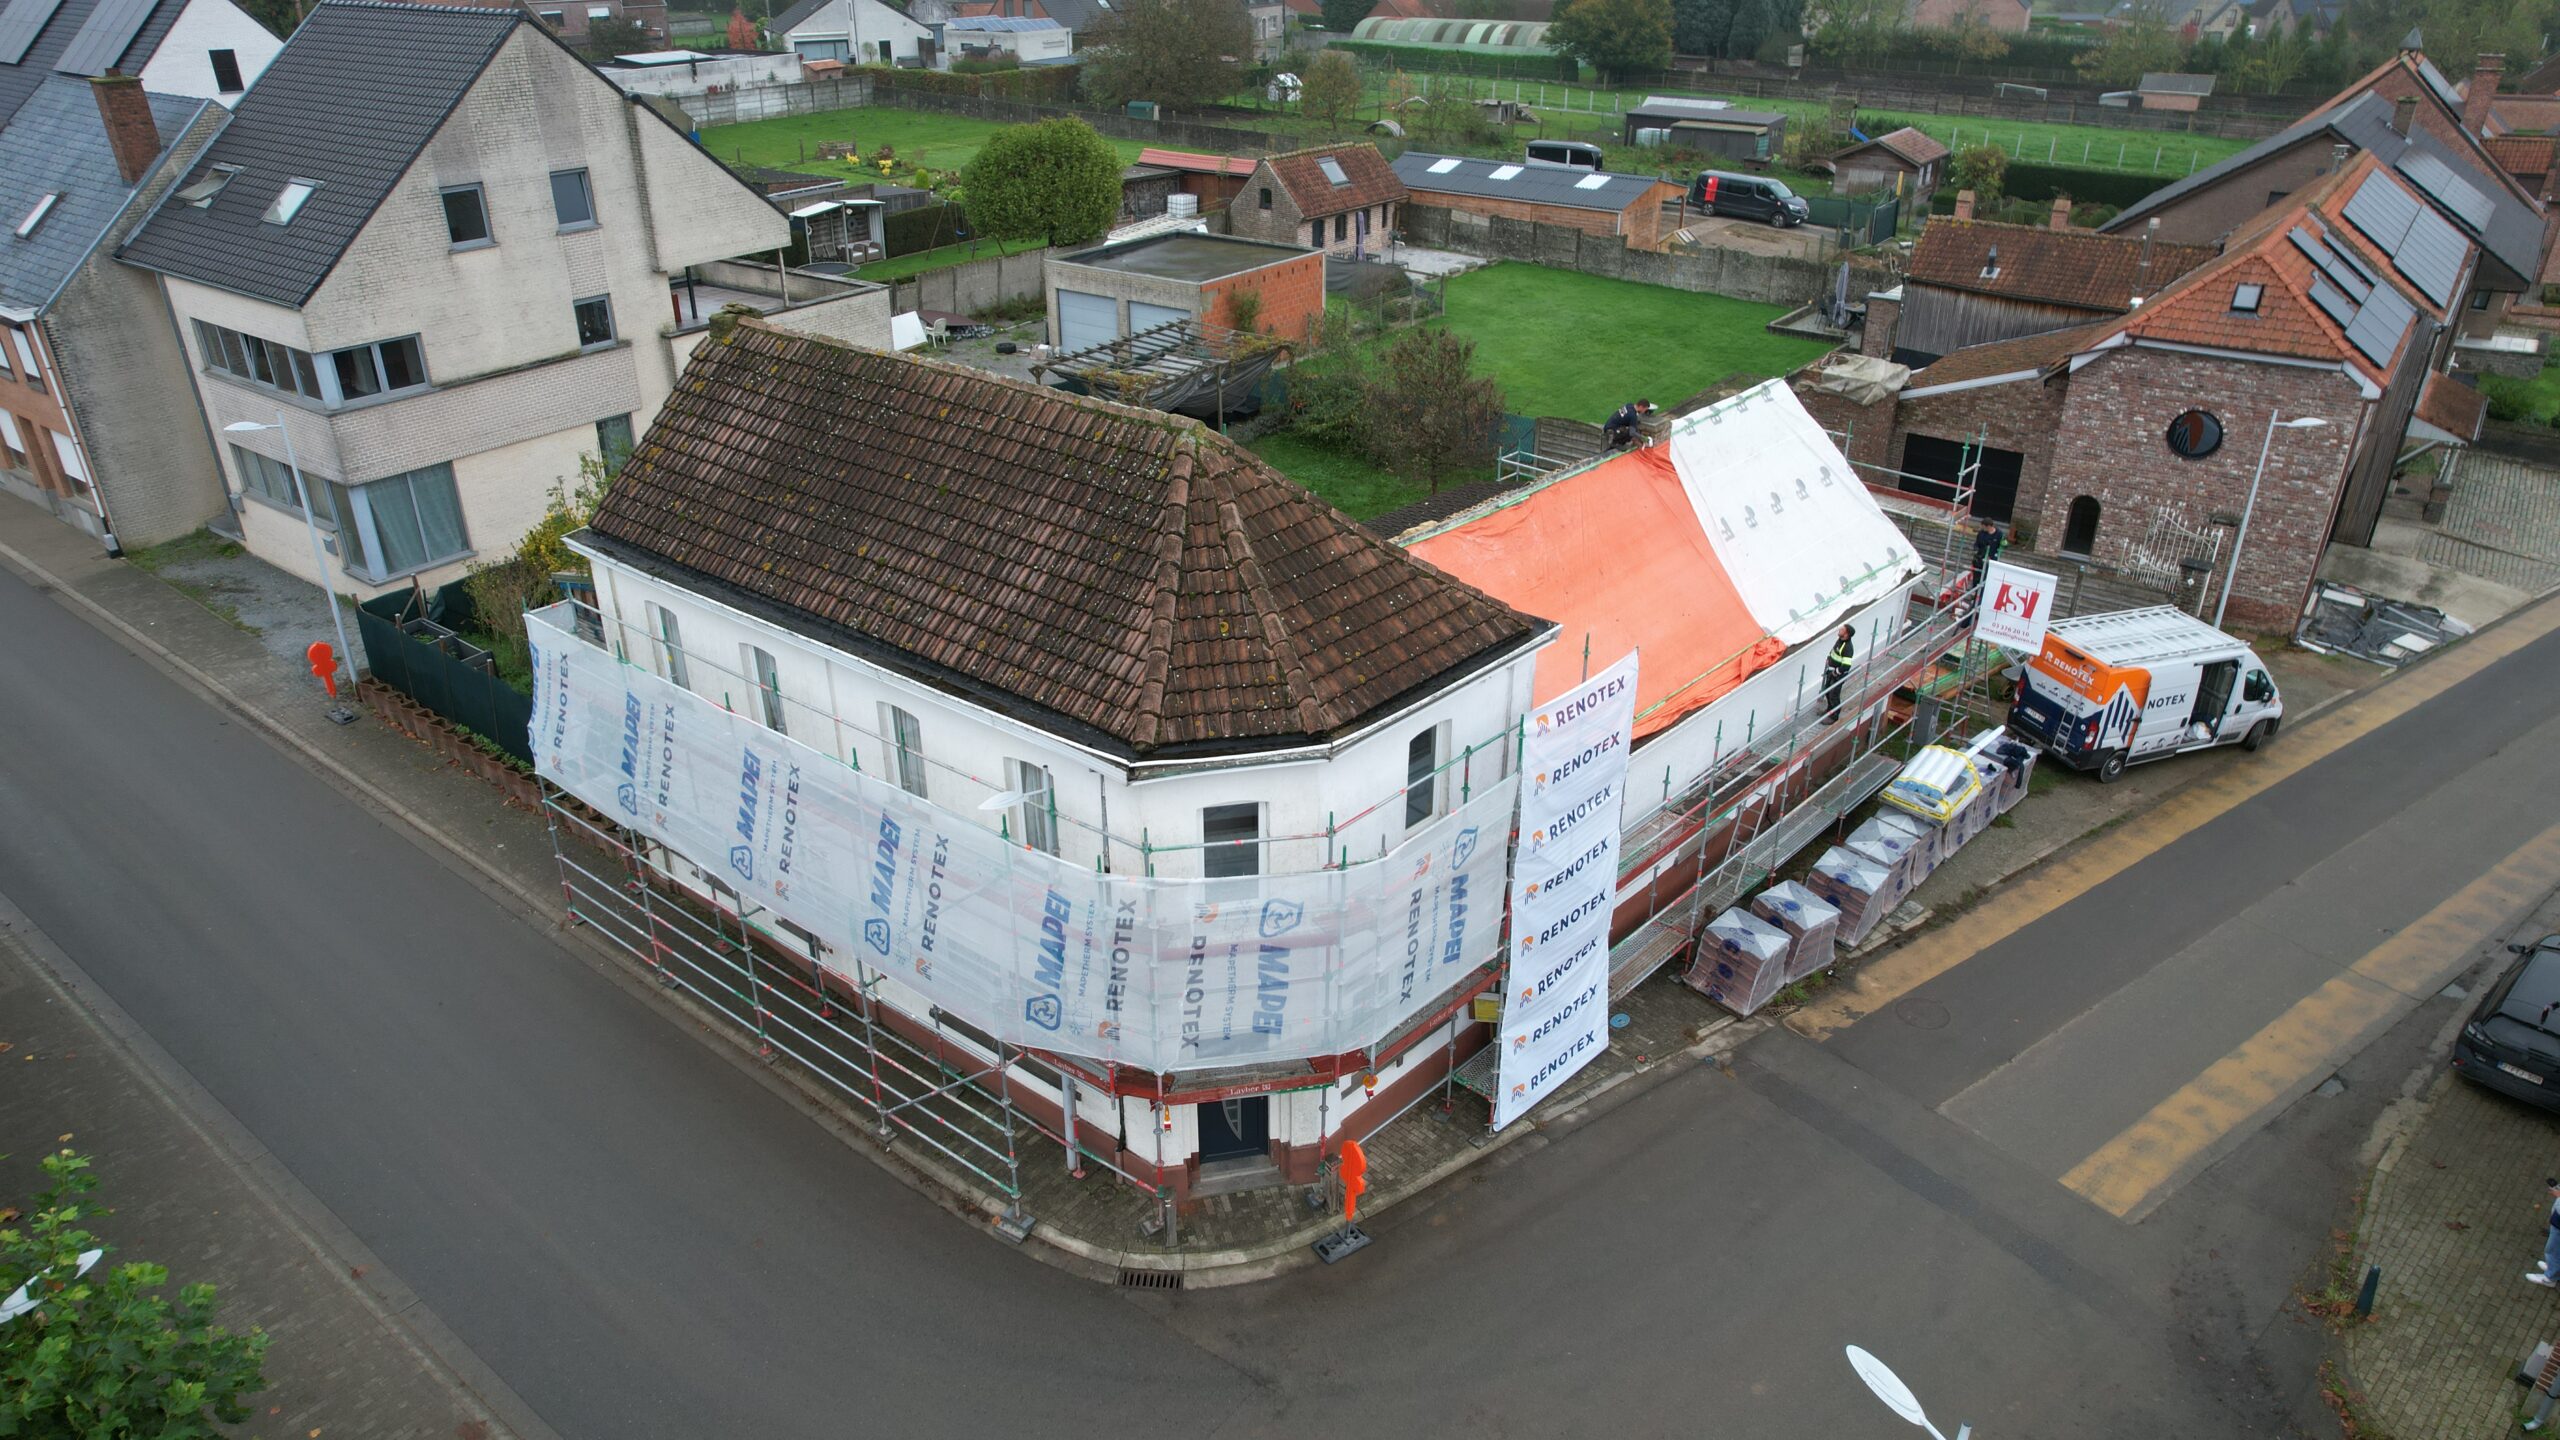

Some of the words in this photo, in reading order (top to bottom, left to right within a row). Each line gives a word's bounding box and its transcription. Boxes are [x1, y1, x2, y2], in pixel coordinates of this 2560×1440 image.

[1993, 583, 2040, 619] ASV
[554, 651, 569, 749] RENOTEX
[1555, 675, 1625, 727] RENOTEX
[2053, 658, 2095, 685] RENOTEX
[621, 692, 641, 779] MAPEI
[659, 703, 675, 807] RENOTEX
[1552, 731, 1620, 784] RENOTEX
[736, 749, 761, 842] MAPEI
[763, 796, 774, 852] MAPETHERM
[769, 760, 777, 794] SYSTEM
[779, 763, 800, 874] RENOTEX
[1549, 784, 1611, 840] RENOTEX
[870, 812, 902, 915] MAPEI
[902, 867, 915, 927] MAPETHERM
[910, 828, 921, 865] SYSTEM
[921, 833, 949, 952] RENOTEX
[1544, 837, 1608, 893] RENOTEX
[1034, 889, 1072, 990] MAPEI
[1078, 938, 1091, 997] MAPETHERM
[1086, 900, 1095, 937] SYSTEM
[1106, 898, 1137, 1012] RENOTEX
[1400, 888, 1422, 1004] RENOTEX
[1443, 874, 1469, 964] MAPEI
[1540, 888, 1606, 945] RENOTEX
[1227, 943, 1239, 1004] MAPETHERM
[1252, 943, 1291, 1036] MAPEI
[1537, 935, 1598, 995] RENOTEX
[1222, 1005, 1235, 1040] SYSTEM
[1532, 984, 1597, 1042] RENOTEX
[1531, 1030, 1595, 1090] RENOTEX
